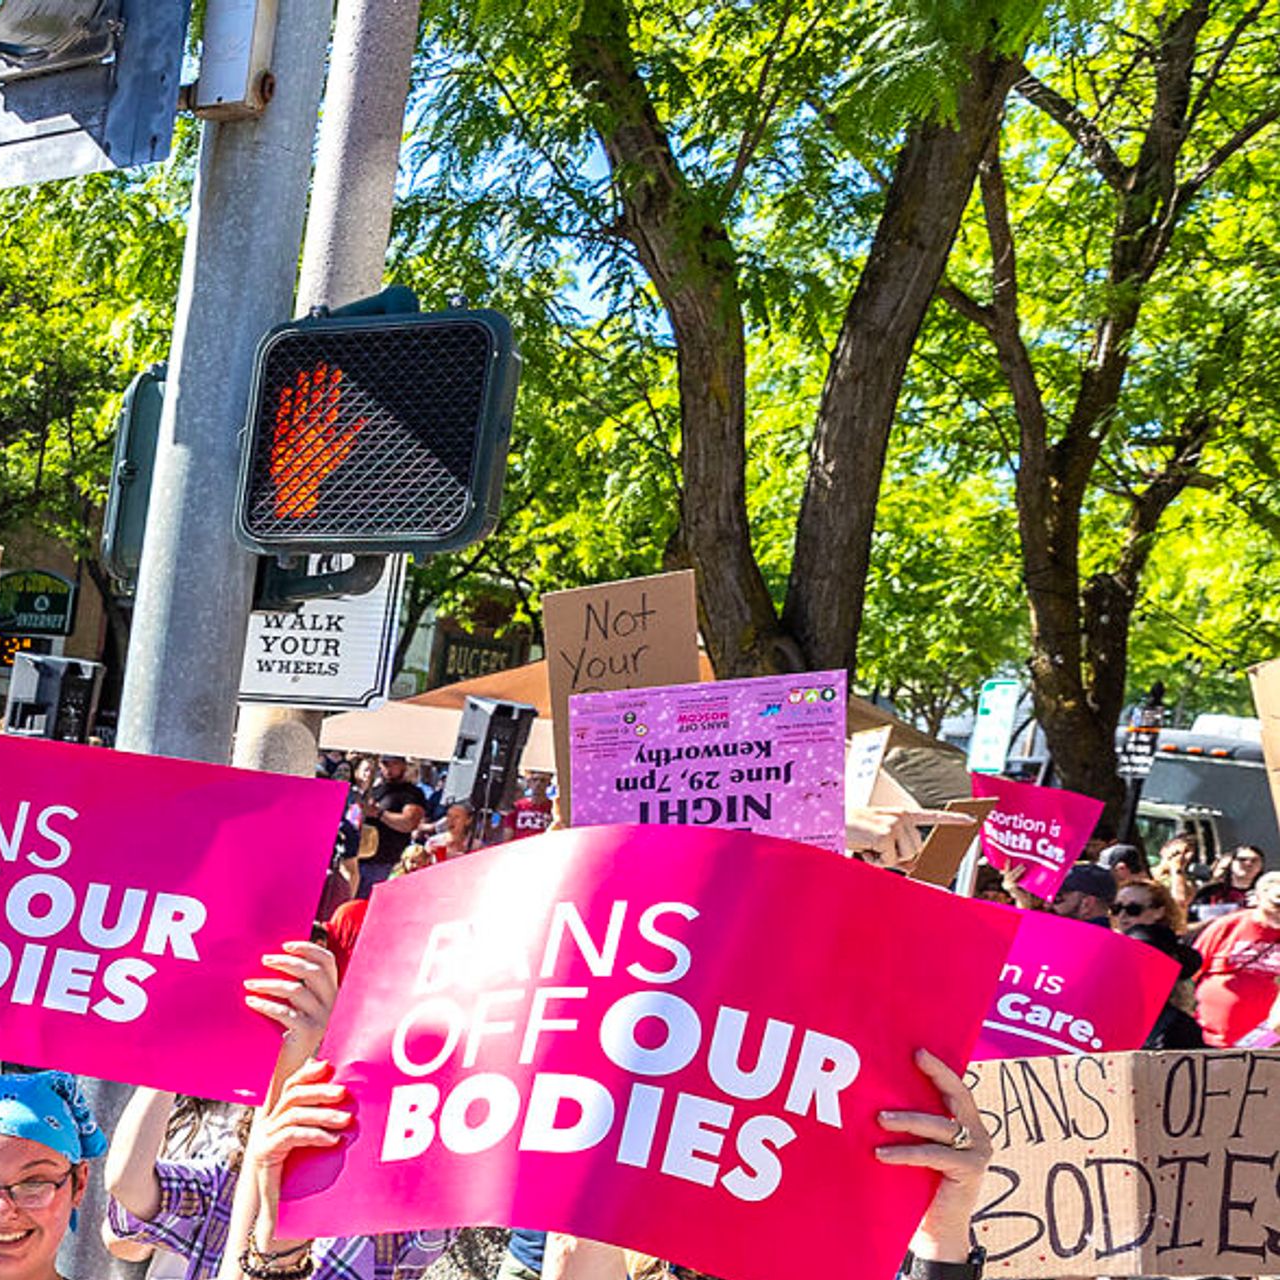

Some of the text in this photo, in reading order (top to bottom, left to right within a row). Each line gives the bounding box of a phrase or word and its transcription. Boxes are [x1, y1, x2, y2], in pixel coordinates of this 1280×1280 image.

[263, 612, 347, 632] WALK
[584, 592, 657, 642] Not
[256, 659, 340, 676] WHEELS
[260, 635, 341, 657] YOUR
[560, 644, 649, 689] Your
[615, 760, 795, 794] June 29, 7pm
[634, 739, 773, 769] Kenworthy
[987, 810, 1062, 838] ortion is
[5, 873, 208, 962] OUR
[413, 900, 700, 995] BNS
[1033, 965, 1066, 994] is
[996, 992, 1103, 1050] Care.
[391, 986, 861, 1128] OFF OUR
[1162, 1052, 1280, 1138] OFF
[381, 1073, 798, 1202] BODIES
[968, 1148, 1280, 1265] BODIE
